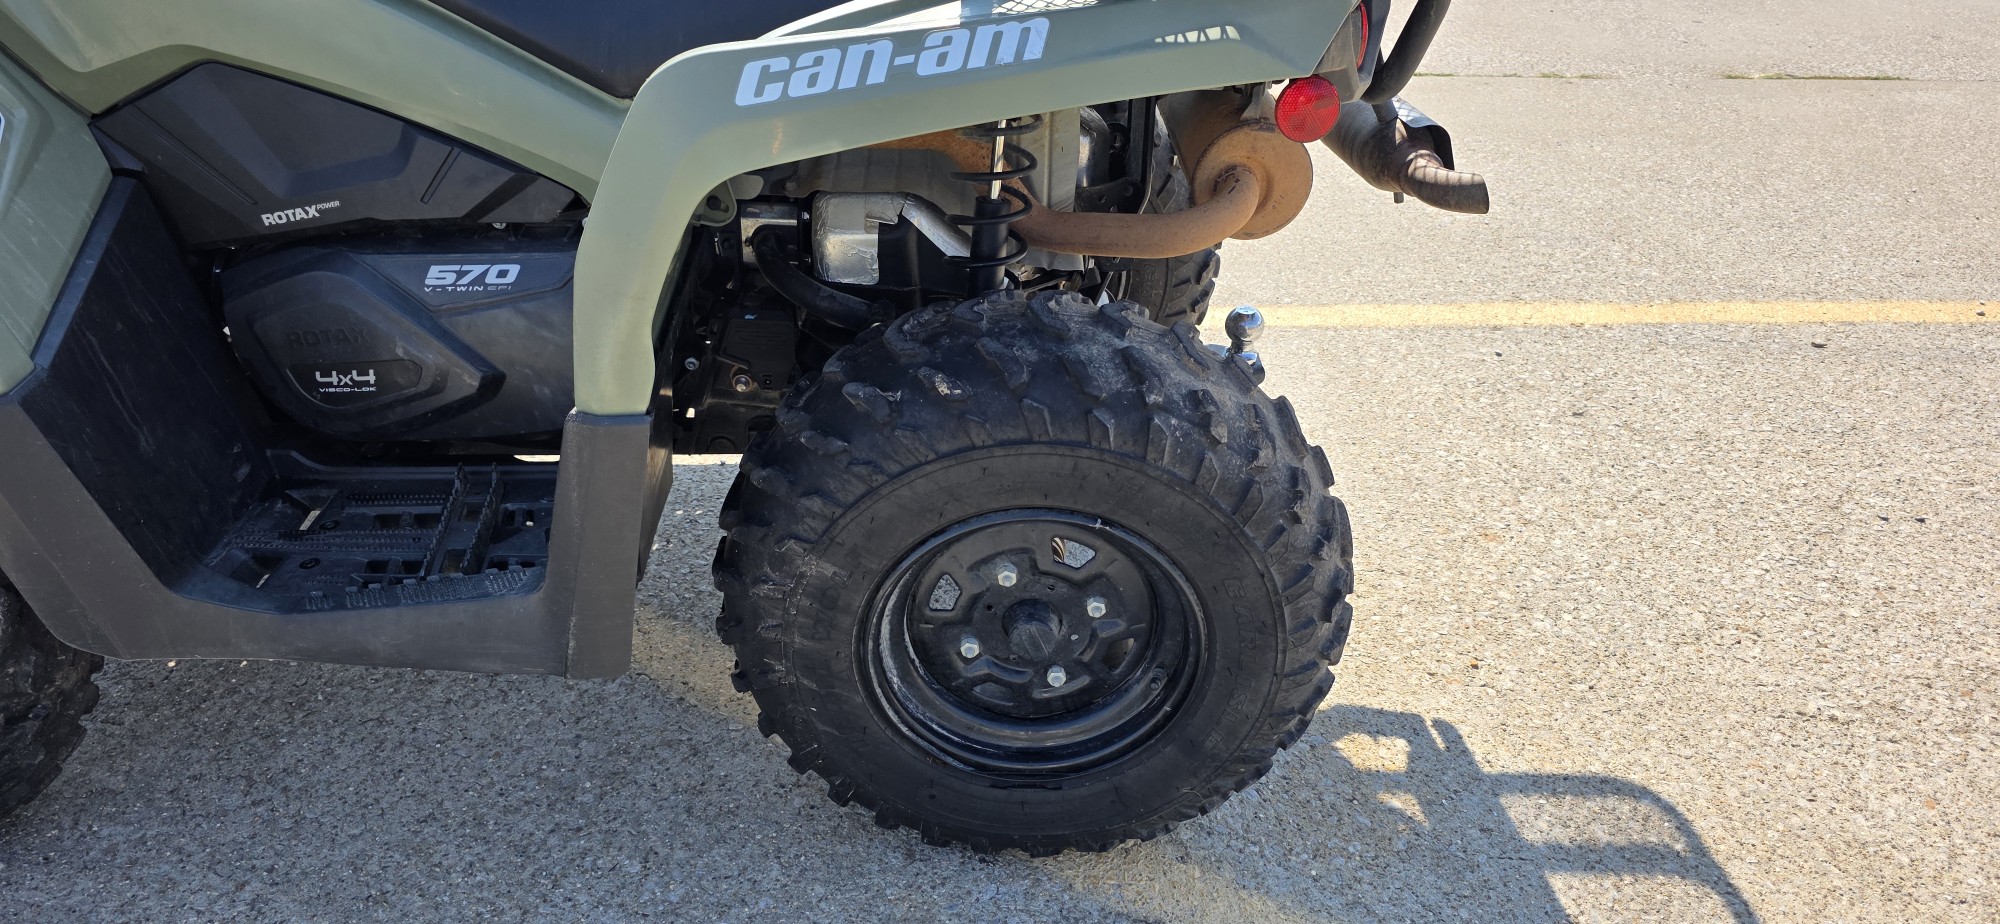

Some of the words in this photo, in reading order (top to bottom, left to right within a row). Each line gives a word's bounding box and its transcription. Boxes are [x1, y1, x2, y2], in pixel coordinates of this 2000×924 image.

[736, 17, 1049, 107] can-am
[261, 205, 320, 226] ROTAX
[317, 200, 340, 210] POWER
[424, 264, 521, 286] 570
[288, 327, 373, 349] ROTAX
[315, 369, 376, 386] 4x4
[1201, 578, 1257, 752] CARLISLE
